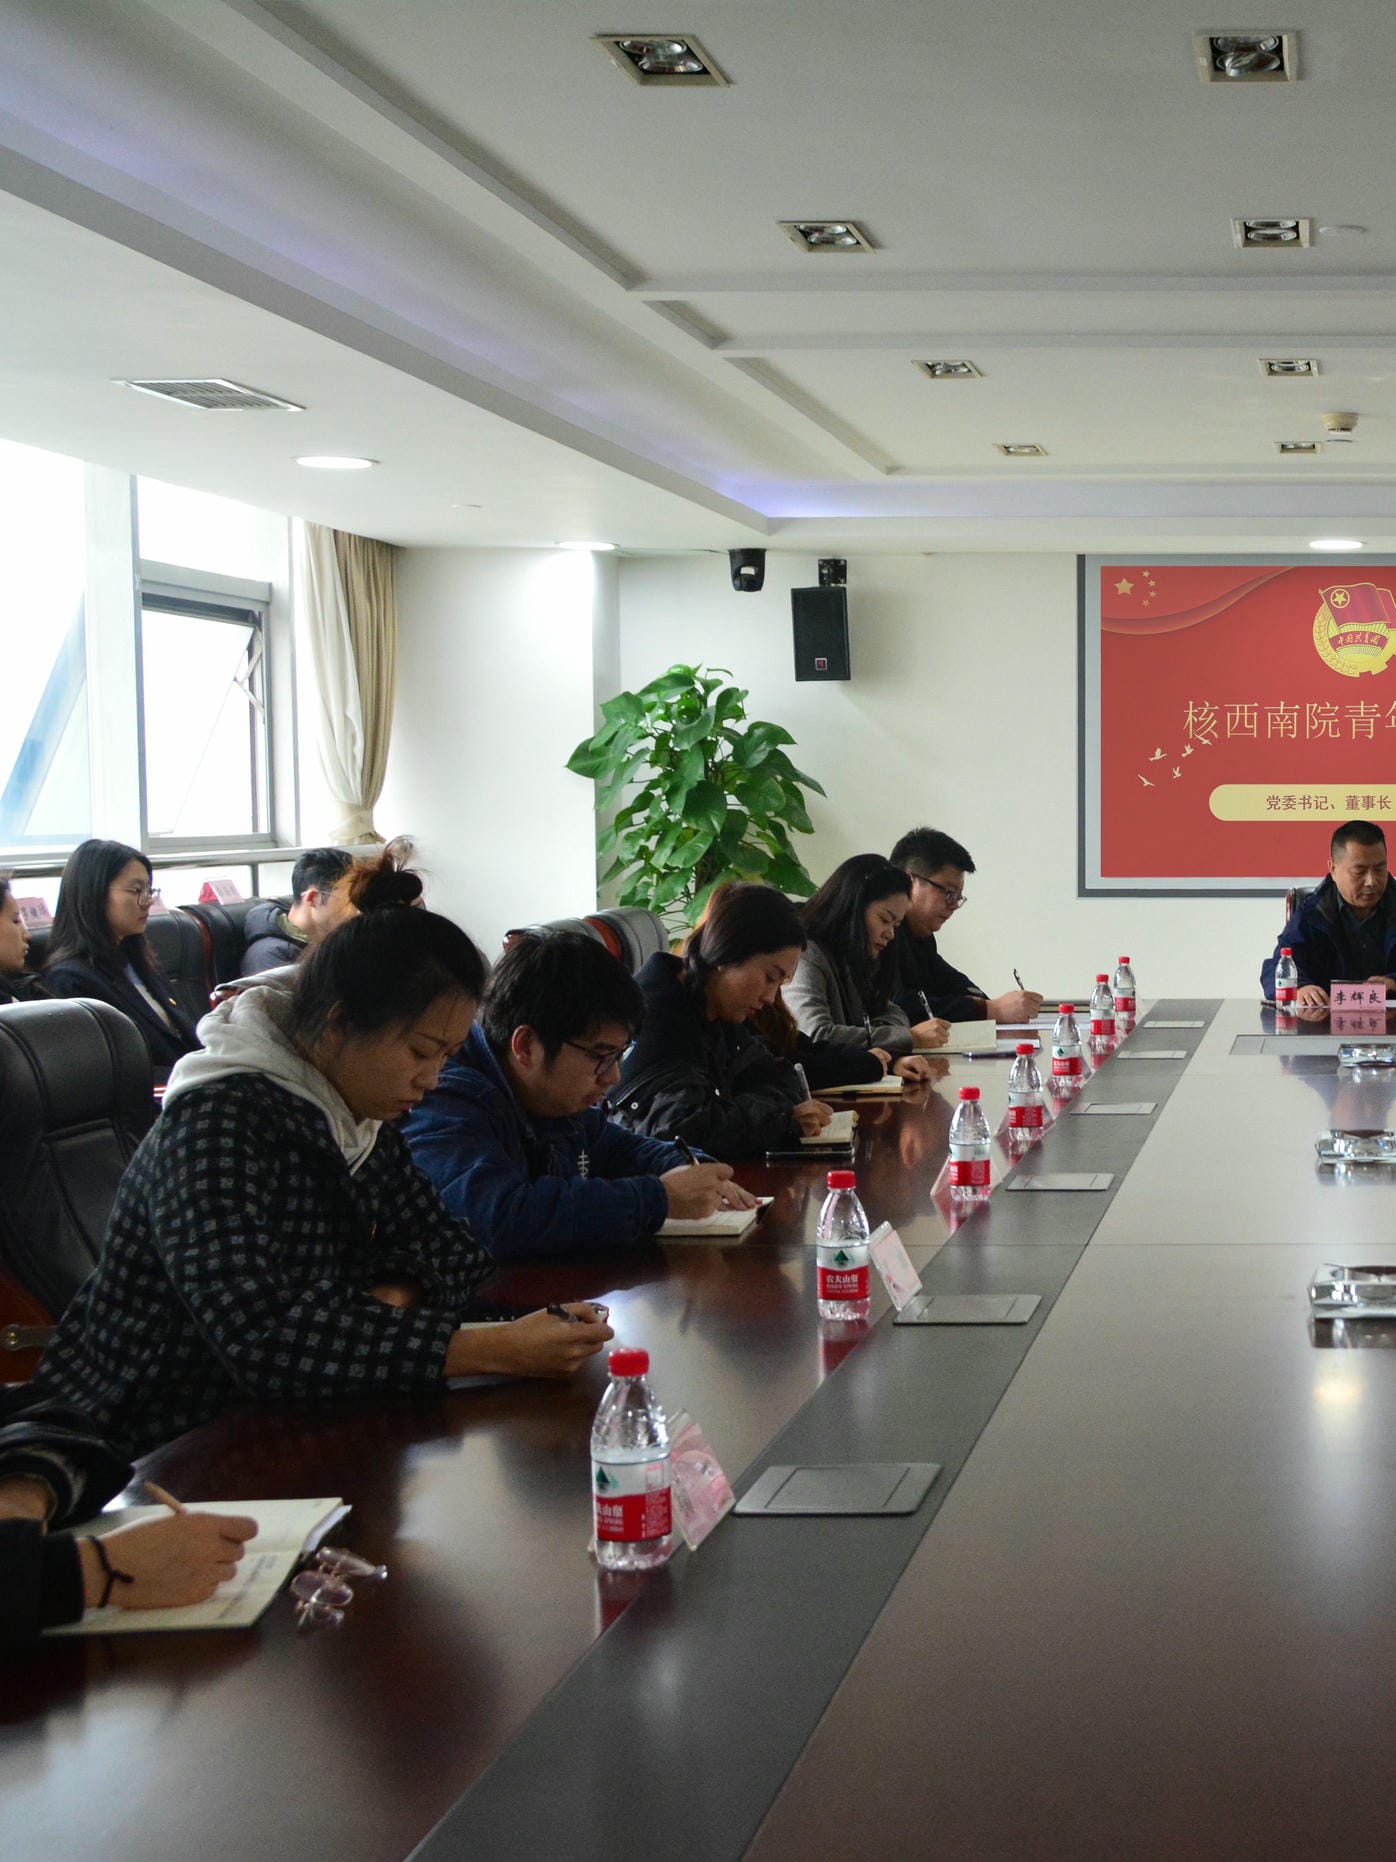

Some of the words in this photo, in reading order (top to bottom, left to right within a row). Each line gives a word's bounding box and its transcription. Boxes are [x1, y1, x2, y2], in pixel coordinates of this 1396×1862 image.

[1265, 794, 1392, 811] 党委书记、董事长
[1333, 989, 1382, 1005] 李辉良
